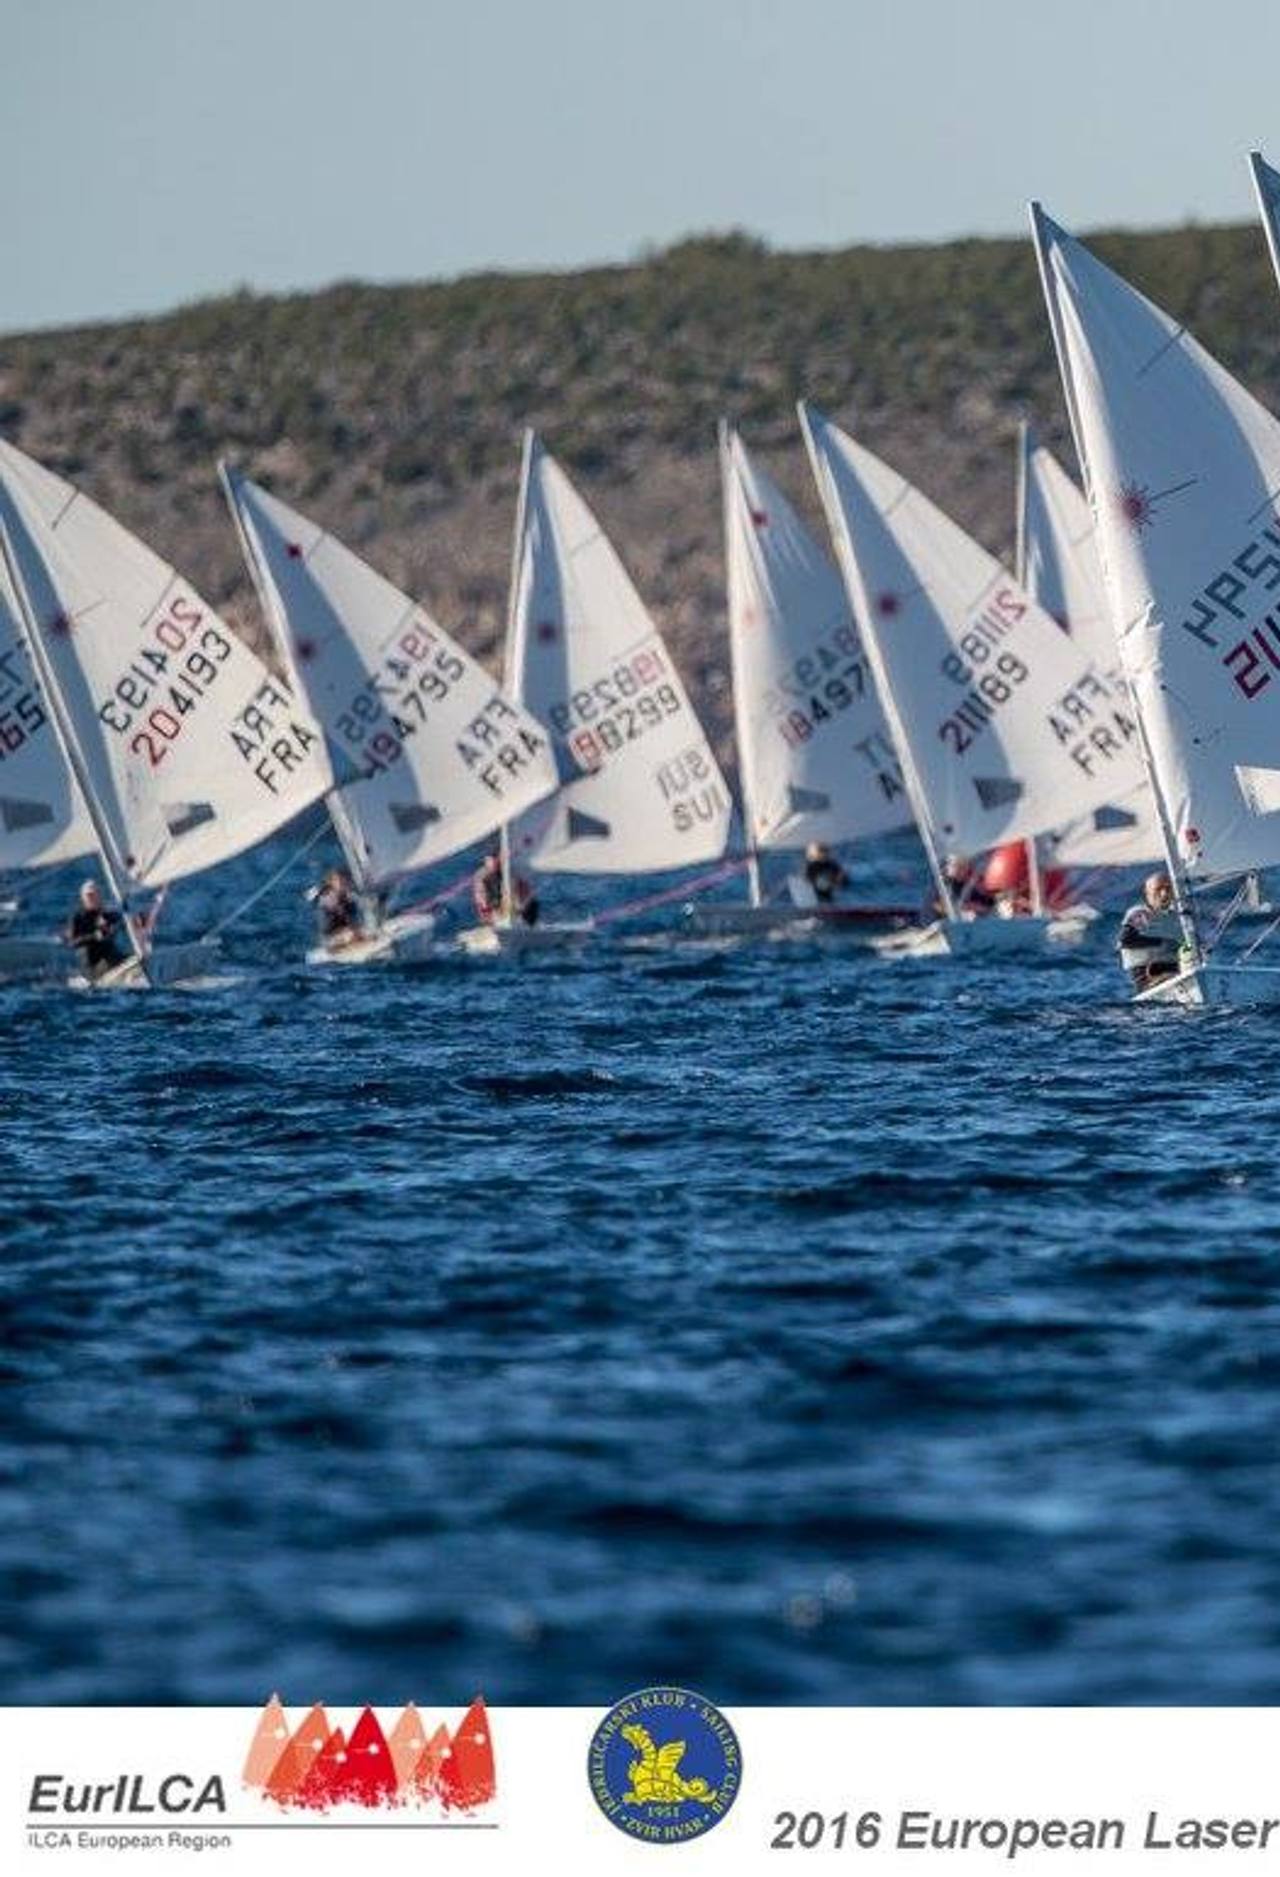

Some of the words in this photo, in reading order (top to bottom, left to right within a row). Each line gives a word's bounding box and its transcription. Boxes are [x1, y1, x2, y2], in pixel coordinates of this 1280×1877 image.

[131, 630, 232, 768] 204193
[938, 652, 1029, 755] 211189
[255, 723, 317, 794] FRA
[478, 732, 545, 798] FRA
[1070, 711, 1136, 776] FRA
